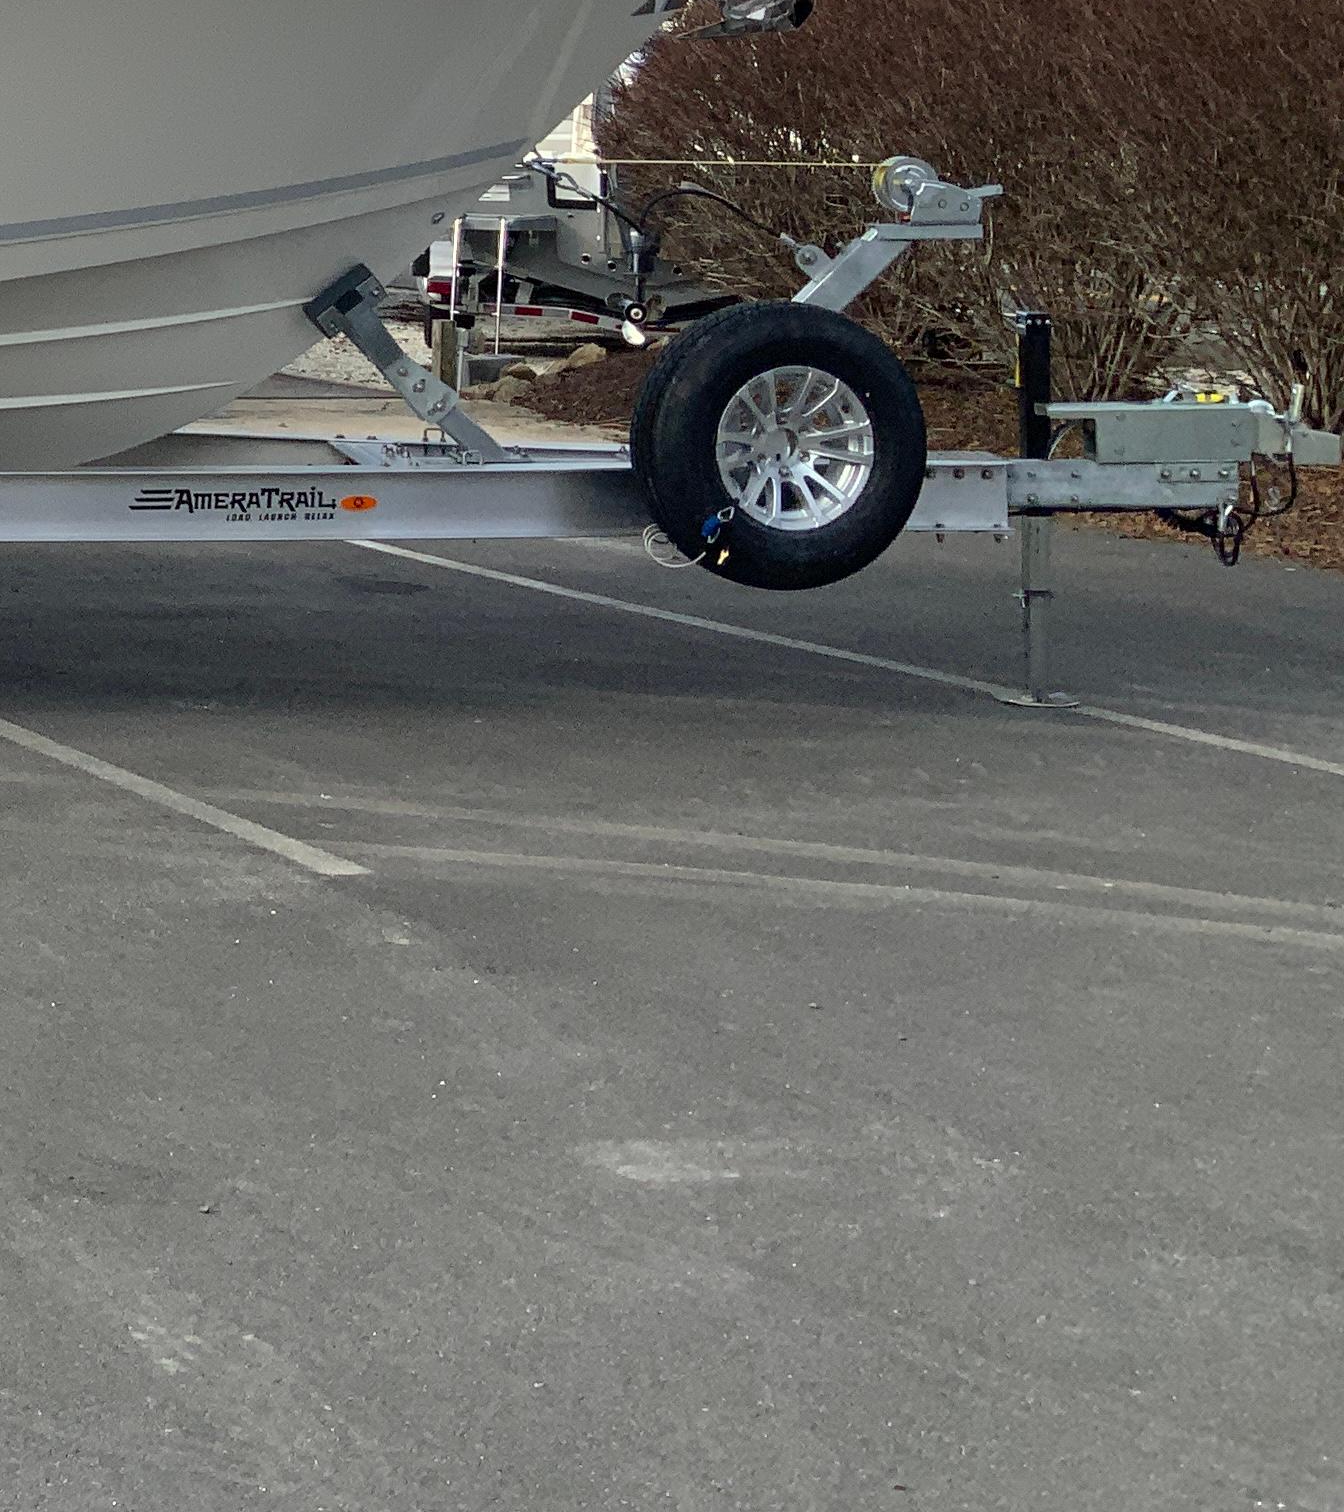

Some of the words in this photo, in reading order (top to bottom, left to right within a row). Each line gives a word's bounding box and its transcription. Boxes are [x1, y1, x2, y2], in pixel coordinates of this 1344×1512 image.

[226, 513, 251, 522] LOAD
[259, 512, 297, 521] LAUNCH
[304, 512, 335, 521] RELAX
